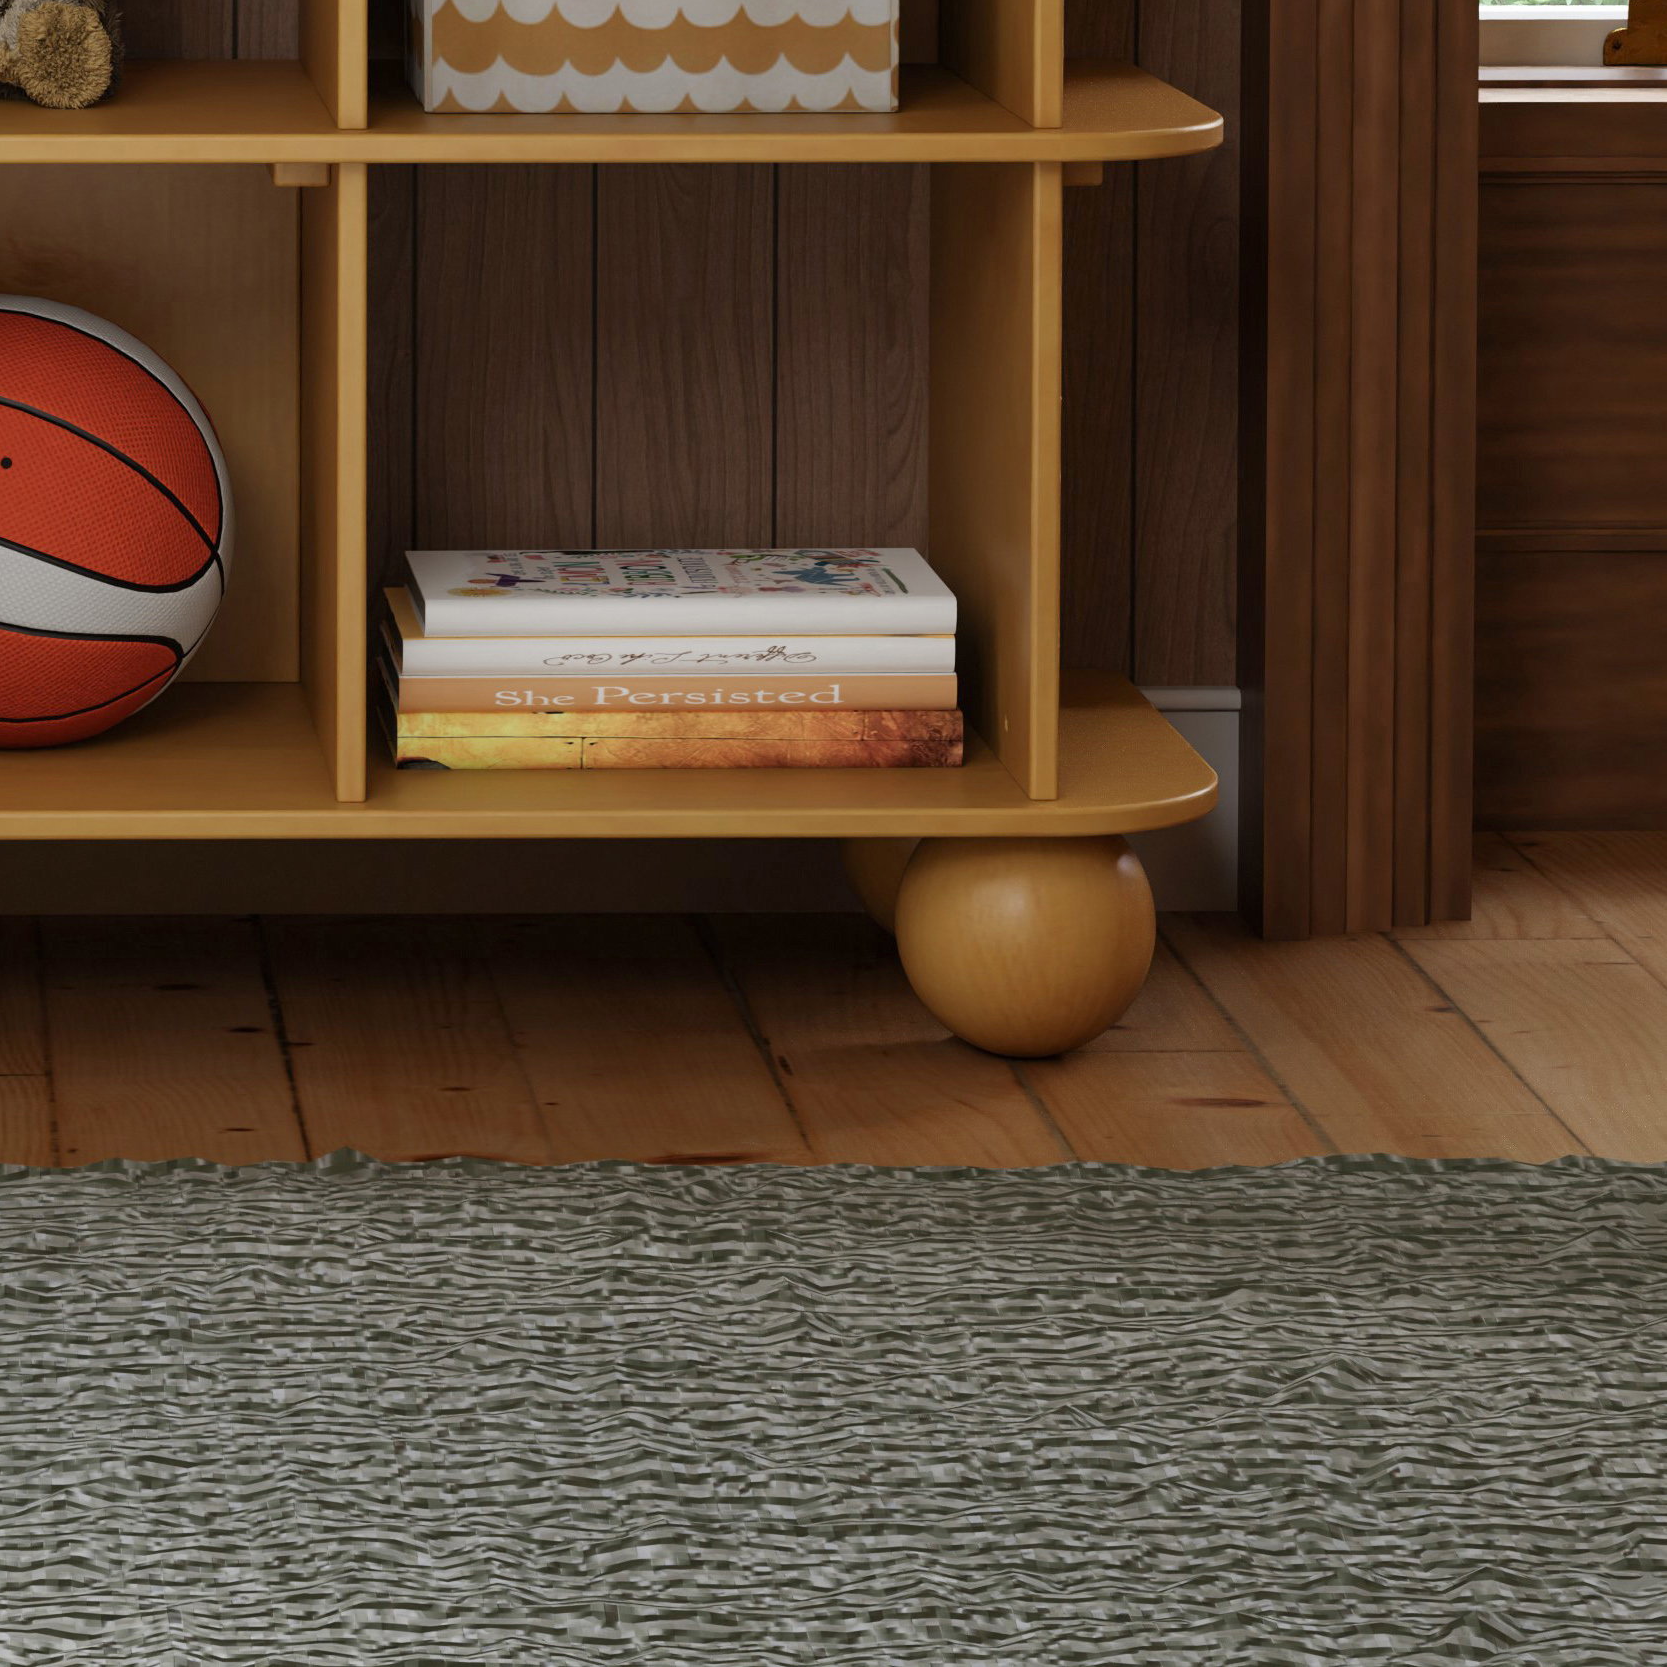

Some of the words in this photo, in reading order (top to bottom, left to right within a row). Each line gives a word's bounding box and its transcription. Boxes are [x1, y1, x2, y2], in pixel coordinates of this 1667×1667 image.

[543, 653, 613, 666] Coco
[682, 645, 817, 665] Different
[494, 689, 576, 707] She
[591, 684, 845, 706] Persisted
